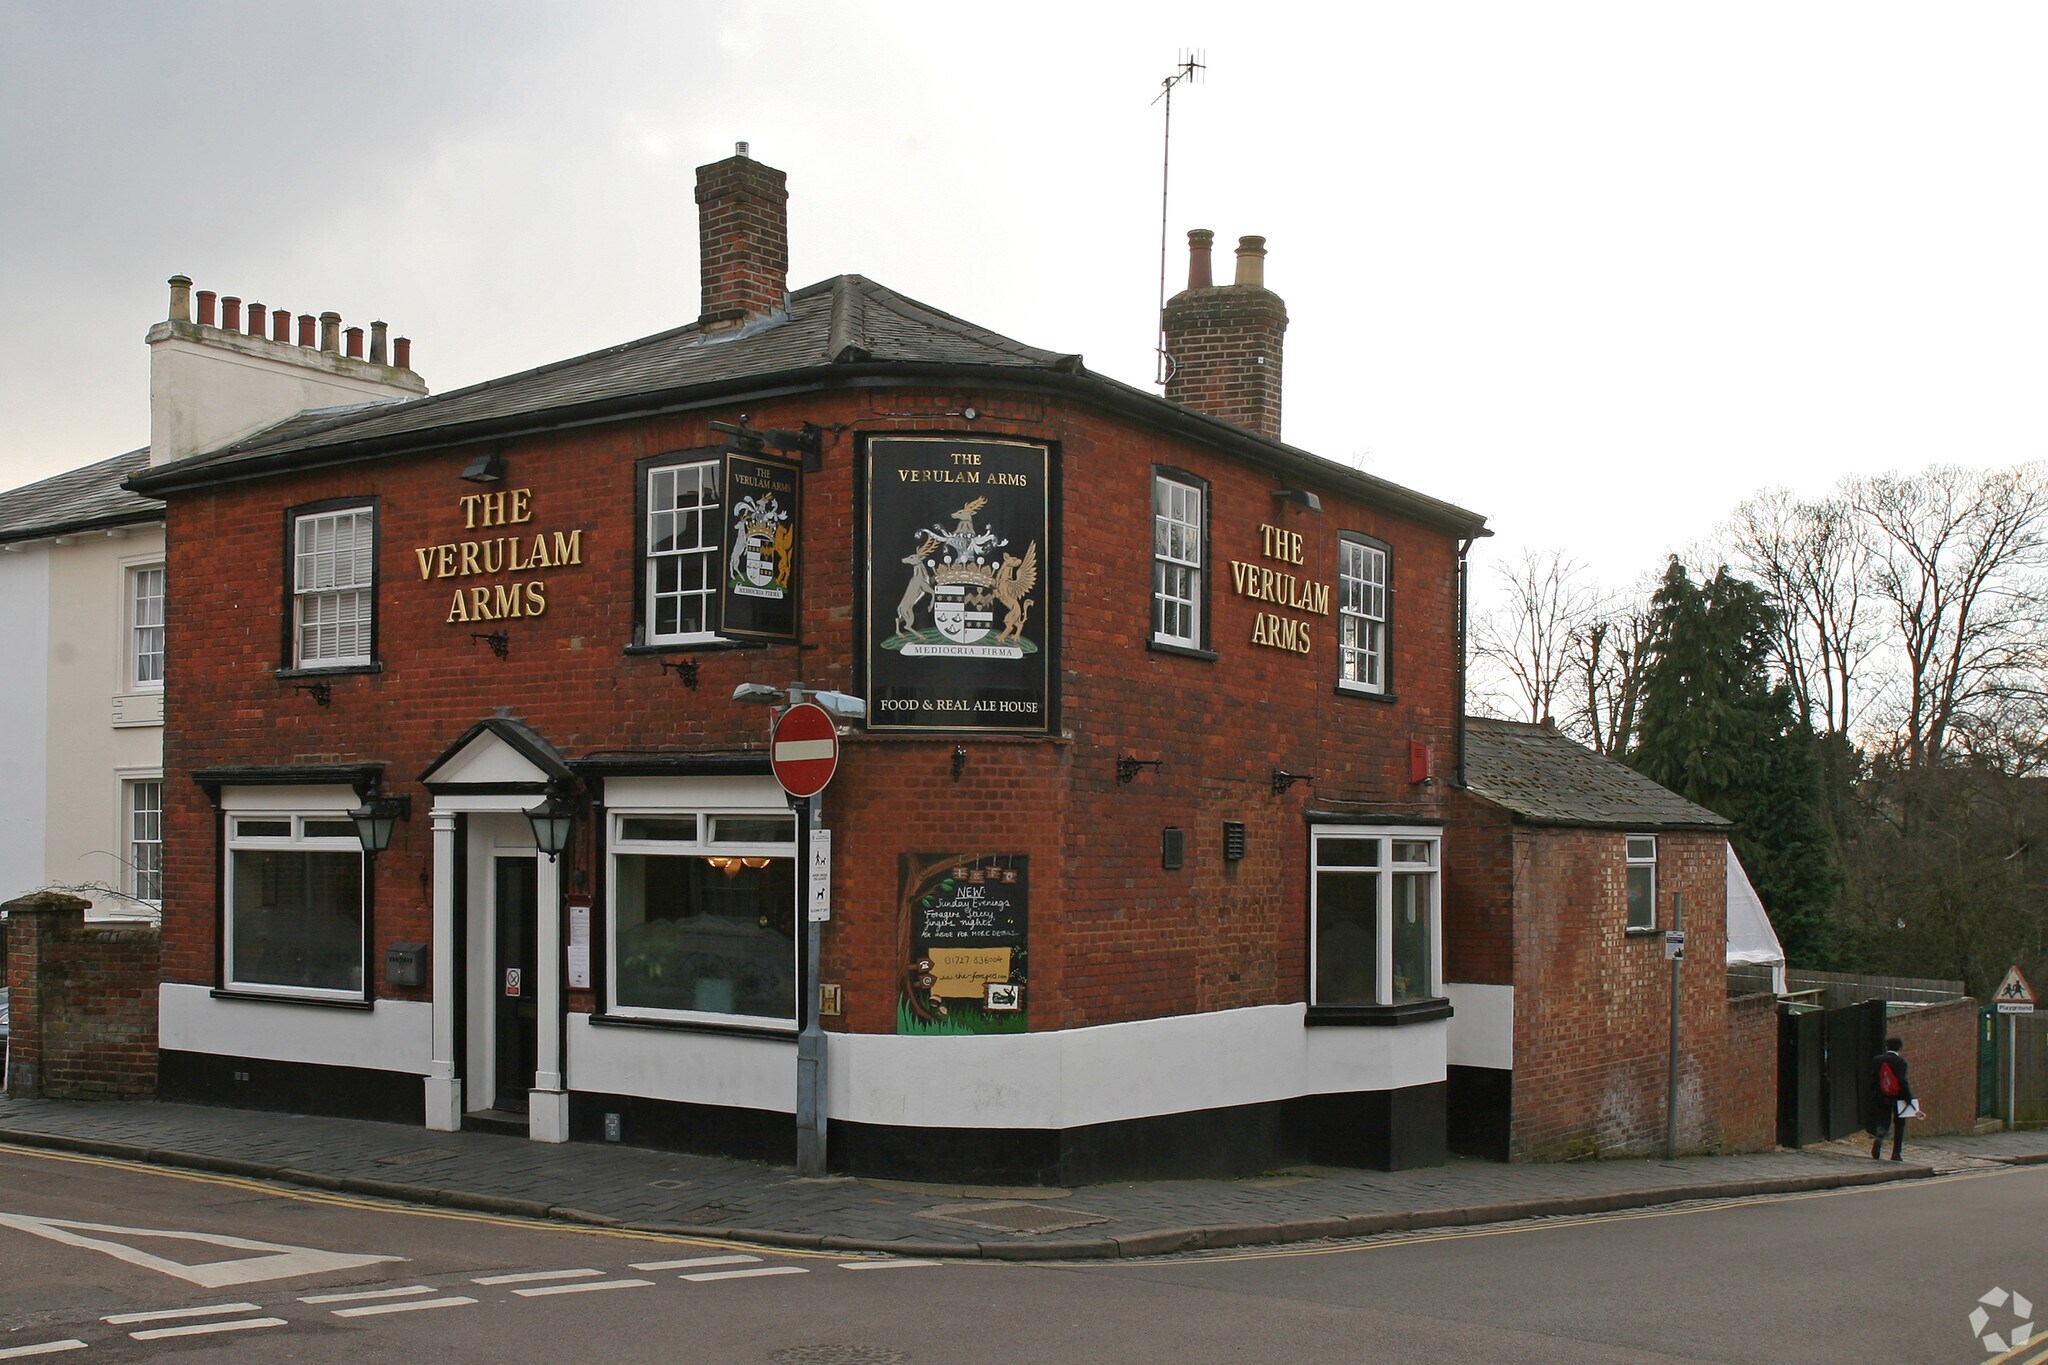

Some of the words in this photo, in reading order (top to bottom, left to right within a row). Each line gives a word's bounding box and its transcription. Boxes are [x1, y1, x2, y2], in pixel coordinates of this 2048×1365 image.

[951, 453, 982, 466] THE
[734, 473, 771, 489] VERULAM
[771, 482, 792, 493] ARMS
[756, 468, 771, 479] THE
[898, 469, 980, 484] VERULAM
[986, 473, 1028, 487] ARMS
[459, 488, 533, 530] THE
[1260, 523, 1305, 566] THE
[415, 529, 583, 581] VERULAM
[1230, 560, 1331, 616] VERULAM
[446, 581, 547, 624] ARMS
[1251, 612, 1311, 655] ARMS
[914, 645, 976, 655] MEDIOCRIA
[981, 647, 1013, 657] FIRMA
[880, 699, 919, 711] FOOD
[922, 699, 934, 711] &
[936, 699, 971, 712] REAL
[973, 700, 997, 713] ALE
[999, 701, 1039, 714] HOUSE
[936, 898, 970, 911] Sunday
[972, 898, 1011, 911] Evenings
[944, 956, 970, 965] 01727
